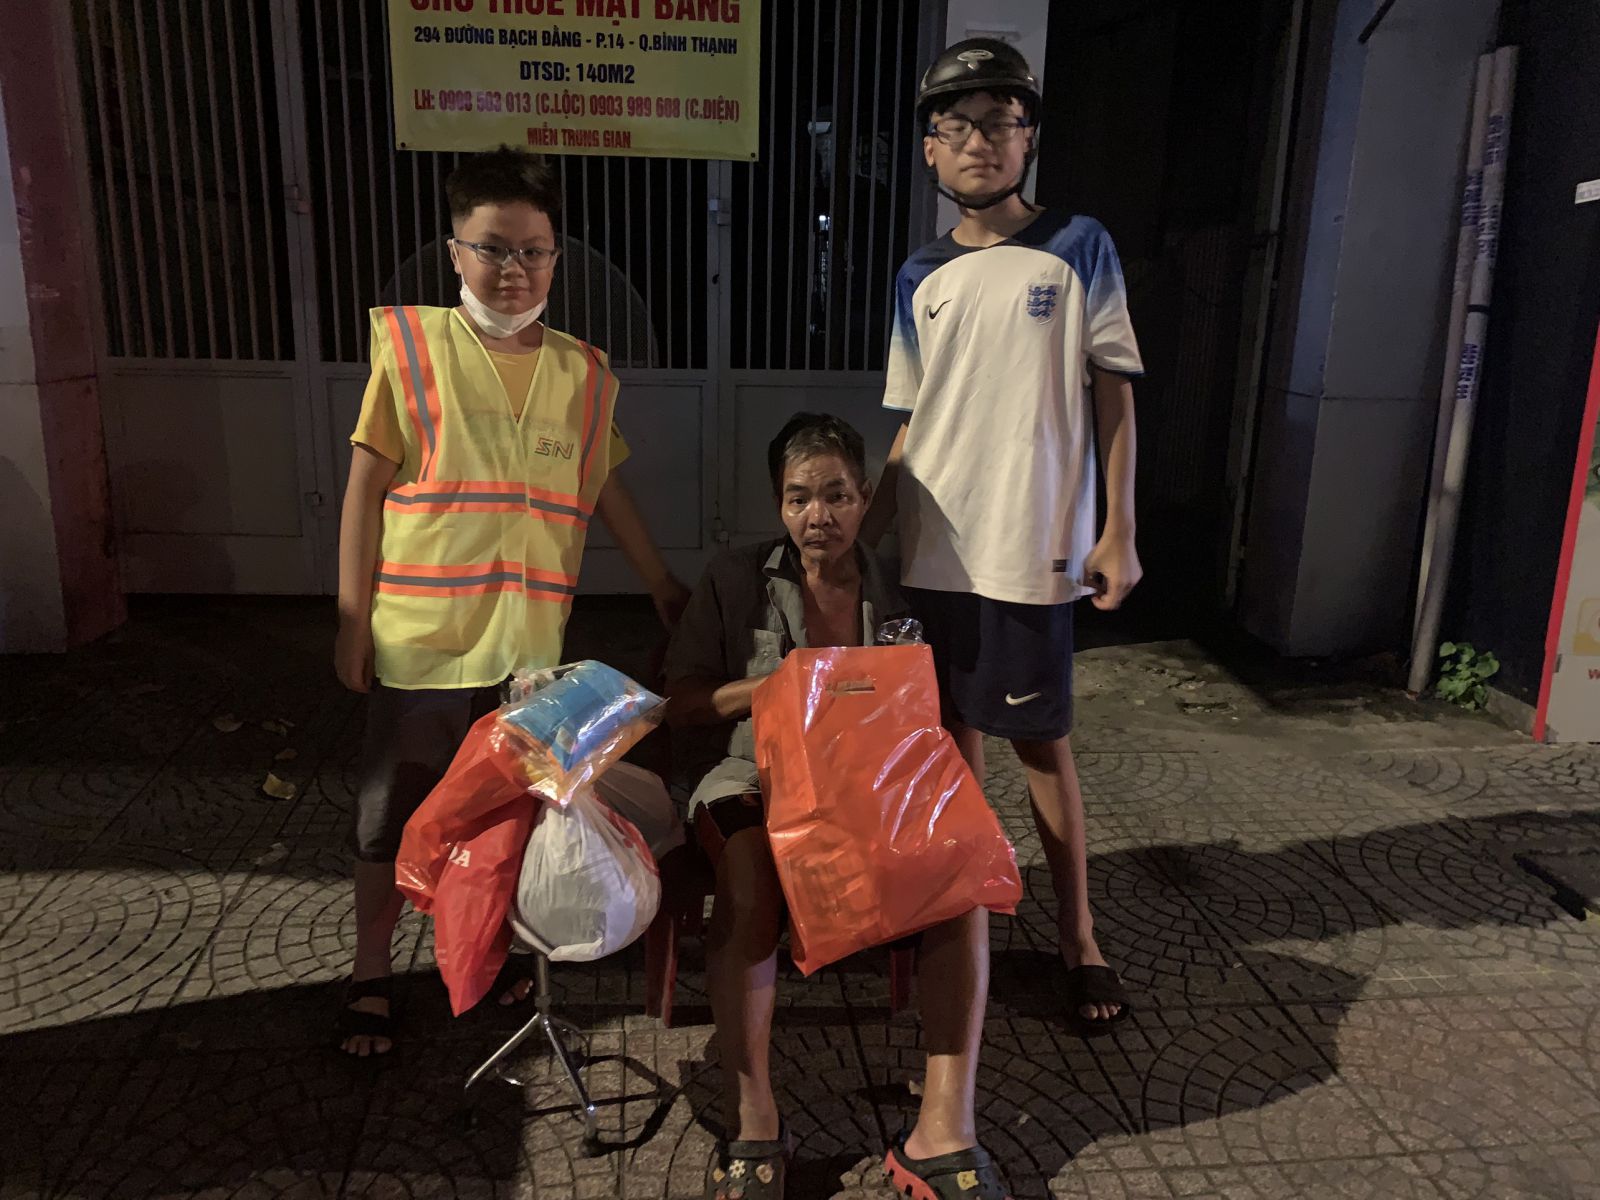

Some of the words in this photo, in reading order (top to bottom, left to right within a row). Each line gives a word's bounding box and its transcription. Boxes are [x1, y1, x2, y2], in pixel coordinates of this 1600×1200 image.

[414, 26, 441, 43] 294
[445, 23, 495, 45] ĐƯỜNG
[498, 29, 538, 48] BẠCH
[596, 33, 625, 49] P.14
[639, 32, 687, 52] Q.BÌNH
[691, 36, 738, 57] THẠNH
[520, 61, 571, 82] DTSD:
[576, 63, 635, 83] 140M2
[414, 89, 435, 110] LH:
[506, 92, 531, 113] 013
[536, 89, 585, 119] (C.LỘC)
[590, 94, 623, 116] 0903
[561, 128, 600, 147] TRUNG
[603, 131, 631, 148] GIAN
